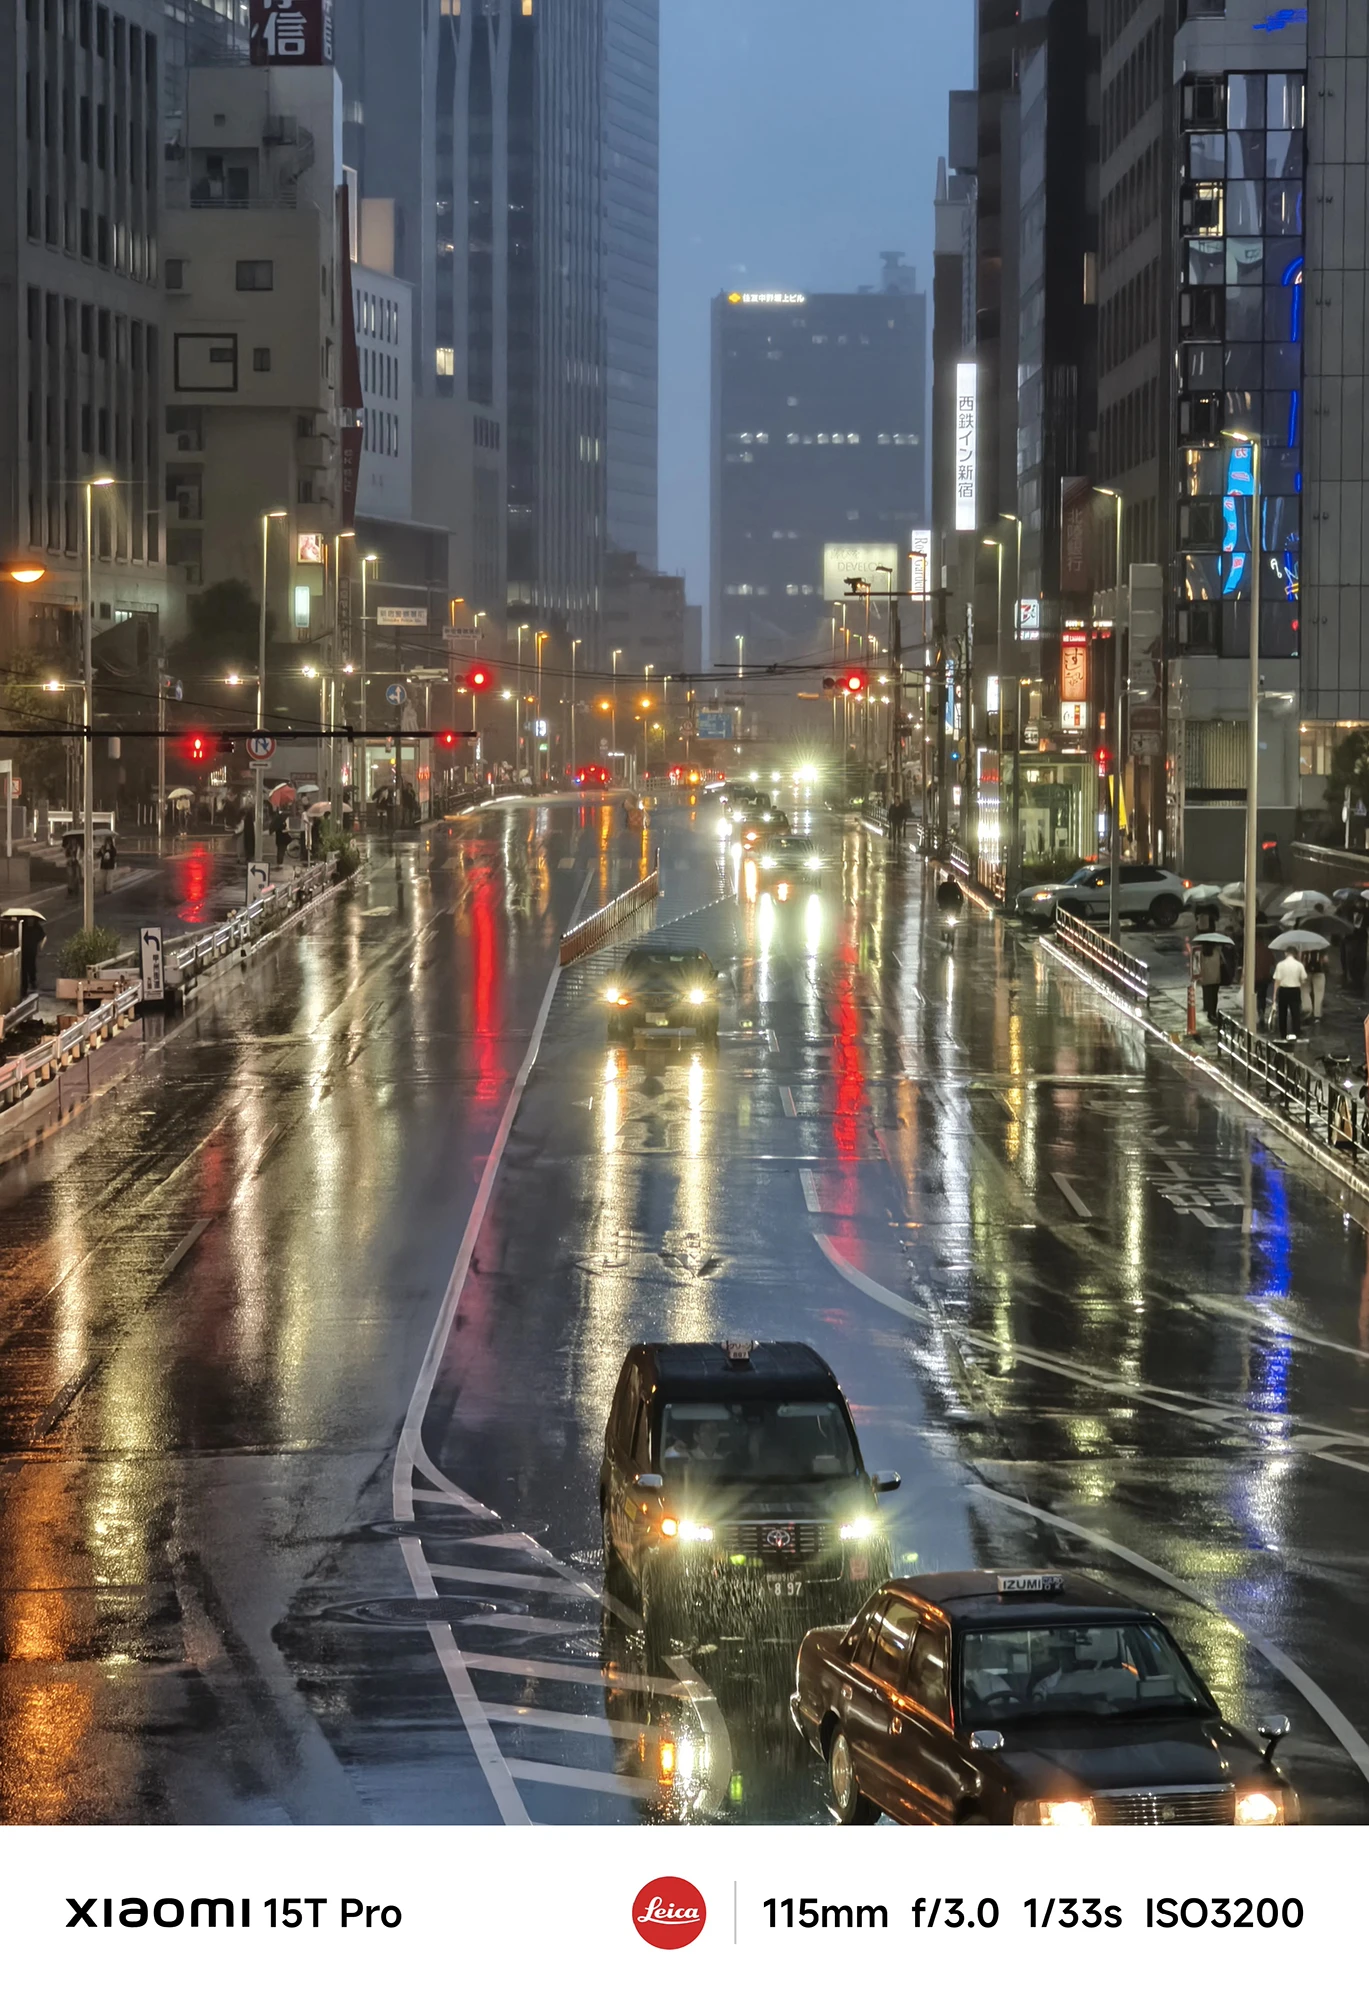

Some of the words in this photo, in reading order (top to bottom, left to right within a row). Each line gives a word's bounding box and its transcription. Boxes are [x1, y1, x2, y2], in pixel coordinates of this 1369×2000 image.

[958, 396, 974, 498] 西鉄イン新宿
[1003, 1579, 1041, 1590] IZUMI
